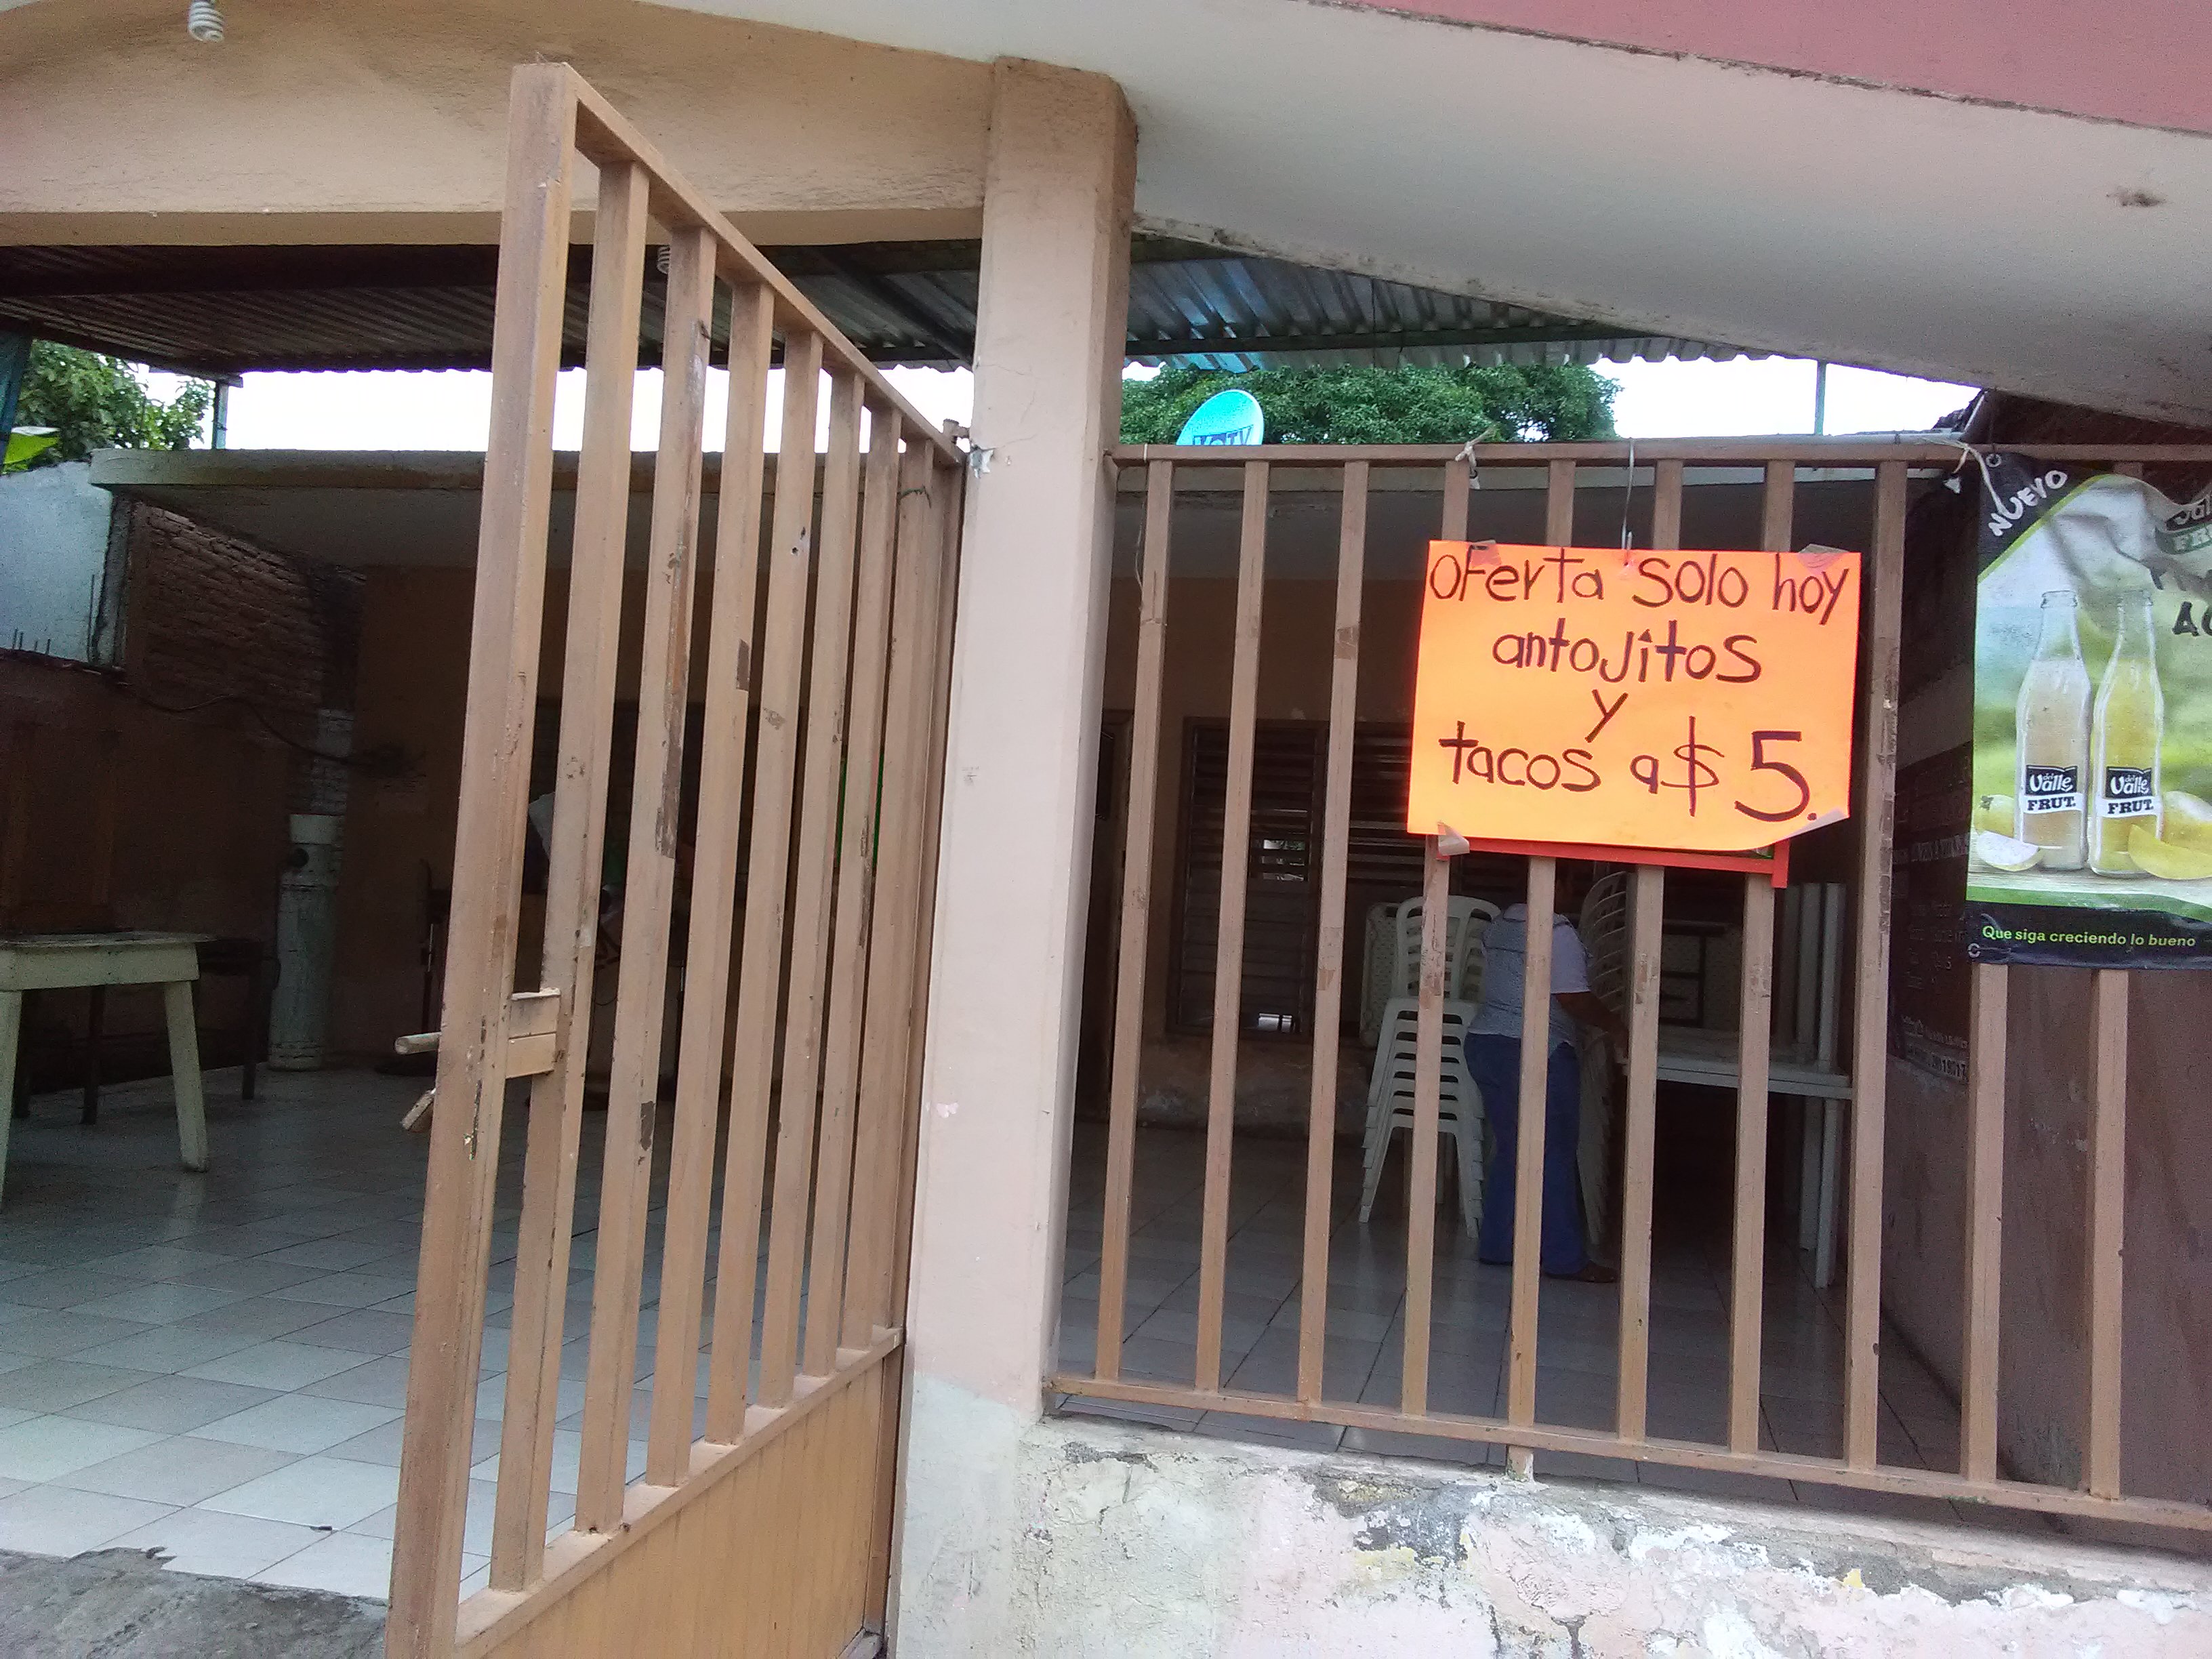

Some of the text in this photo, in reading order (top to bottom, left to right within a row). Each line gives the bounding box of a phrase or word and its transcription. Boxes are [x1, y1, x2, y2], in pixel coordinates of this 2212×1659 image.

[1987, 470, 2068, 537] NUEVO
[1771, 552, 1849, 625] hoy
[1439, 721, 1601, 792] tacos
[2029, 773, 2074, 792] Valle
[2110, 776, 2150, 795] Valle
[1982, 925, 2013, 941] Que
[2015, 928, 2046, 943] siga
[2049, 931, 2127, 945] creciendo
[2130, 933, 2145, 946] lo
[2148, 933, 2196, 947] bueno
